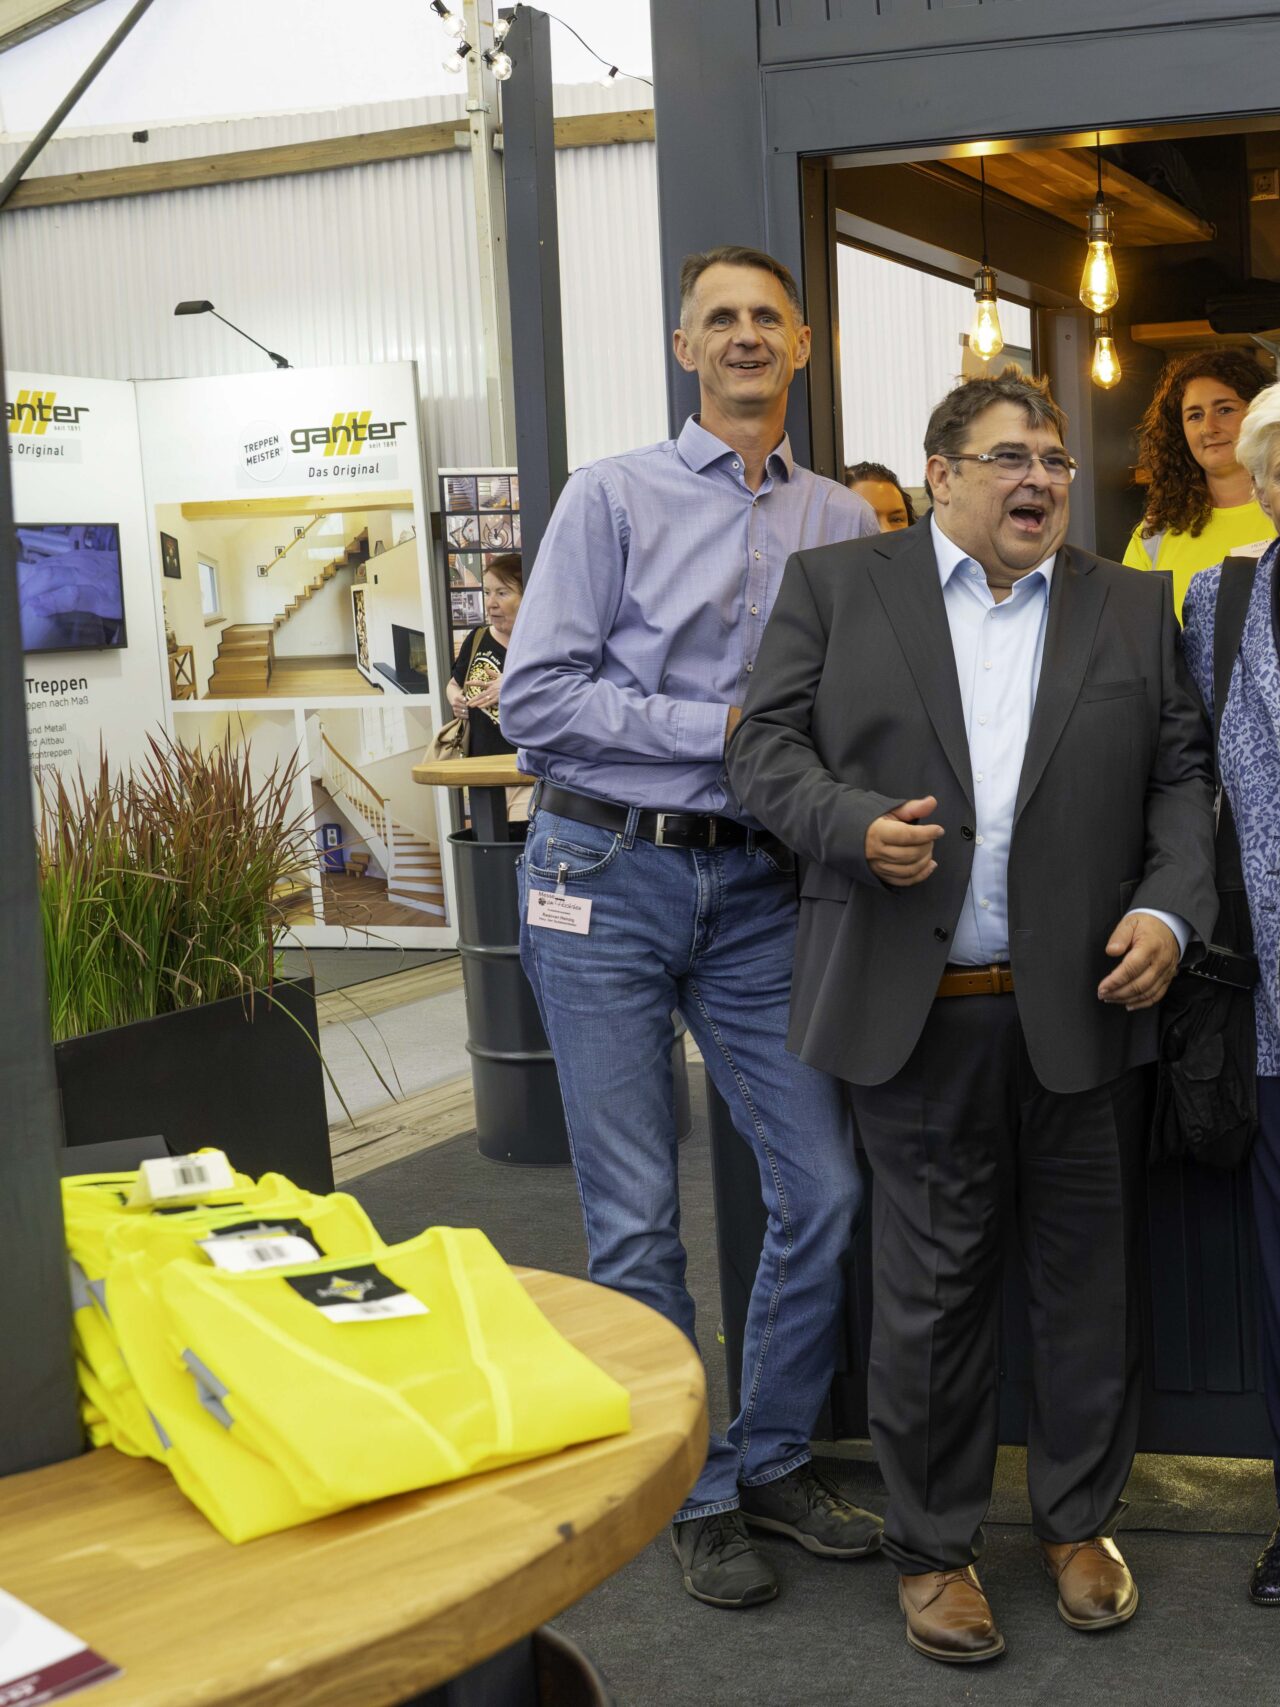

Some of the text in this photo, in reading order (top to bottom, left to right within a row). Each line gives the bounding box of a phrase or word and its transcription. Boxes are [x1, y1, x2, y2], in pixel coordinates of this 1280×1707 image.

[5, 398, 89, 423] anter
[290, 418, 407, 453] ganter
[18, 443, 64, 457] Original
[244, 435, 279, 453] TREPPEN
[246, 448, 280, 466] MEISTER
[308, 463, 379, 478] Das Original
[25, 678, 88, 696] Treppen
[25, 701, 47, 711] ppen
[50, 698, 69, 707] nach
[44, 724, 67, 732] Metall
[40, 737, 64, 746] Altbau
